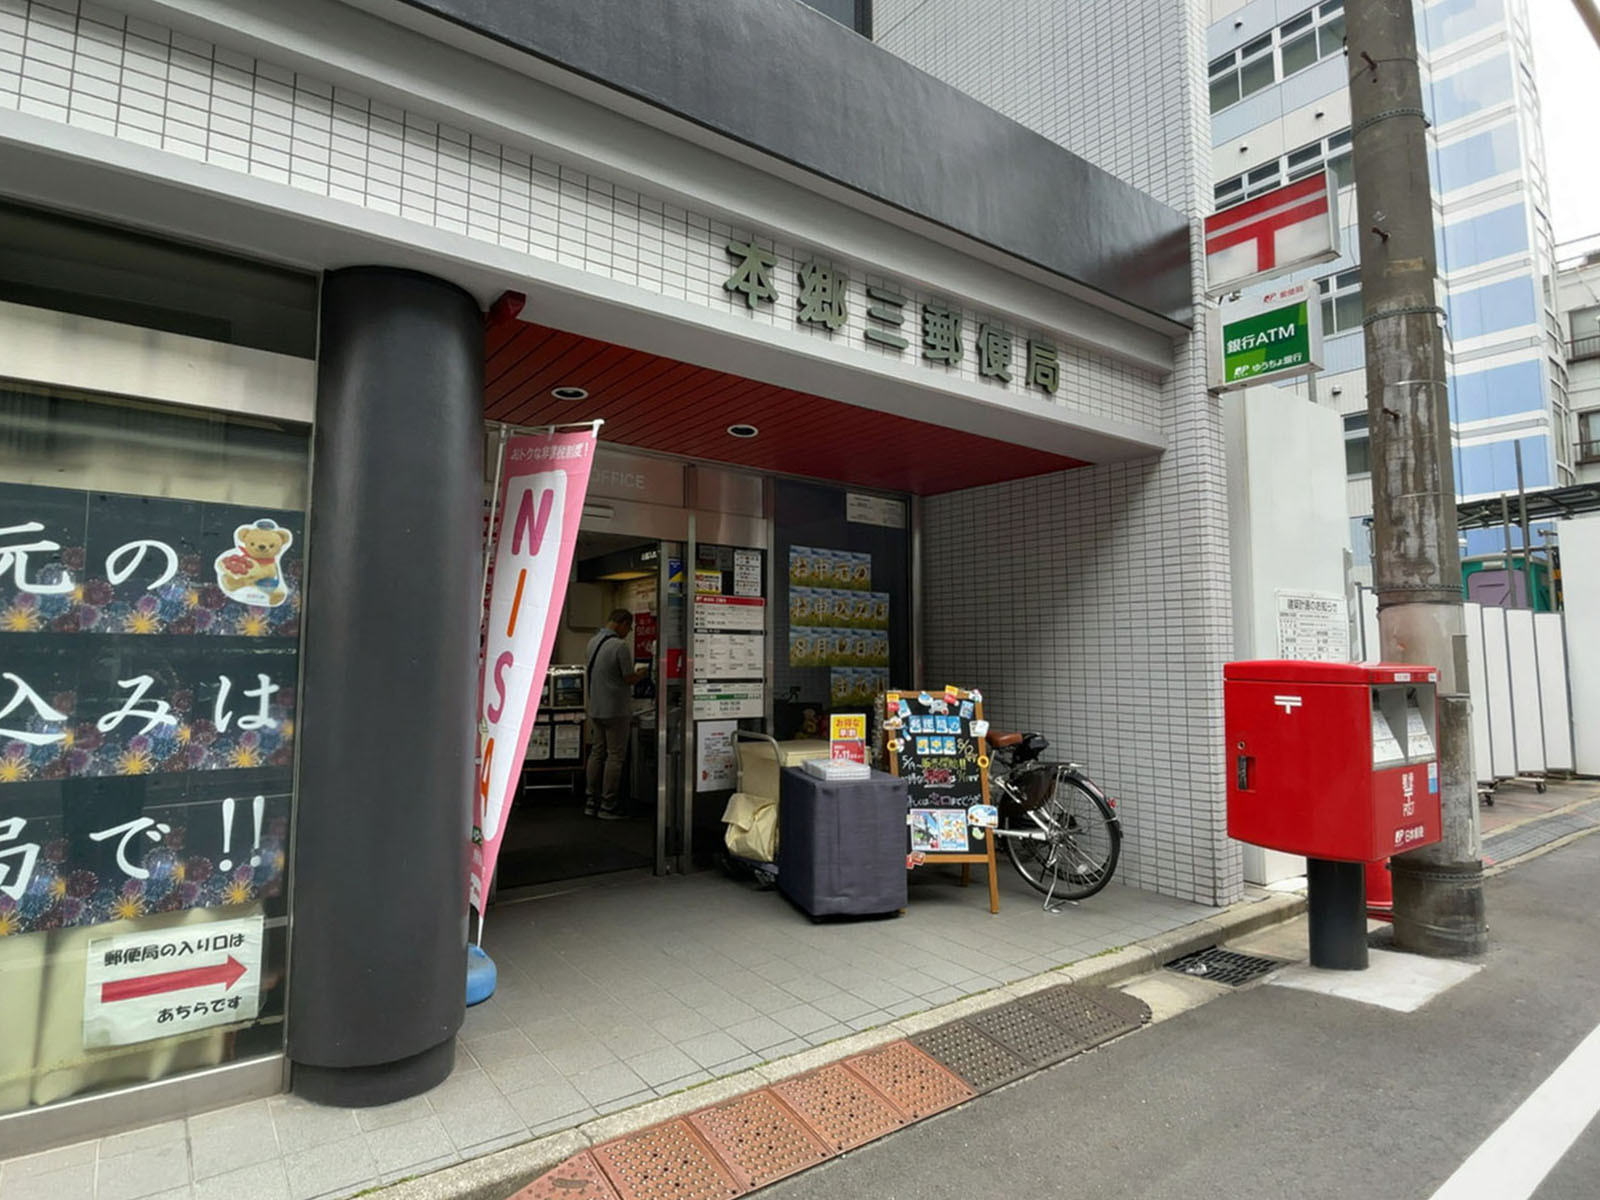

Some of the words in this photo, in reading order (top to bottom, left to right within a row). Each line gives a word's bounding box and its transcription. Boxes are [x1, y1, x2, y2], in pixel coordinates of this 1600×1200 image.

[724, 240, 1061, 394] 本郷三郵便局
[1227, 323, 1295, 354] 銀行ATM
[1252, 353, 1302, 371] ゆうちょ銀行
[791, 557, 868, 582] お中元の
[790, 598, 888, 622] お申込みは
[104, 933, 245, 967] 郵便局の入り口は
[157, 995, 243, 1024] あちらです
